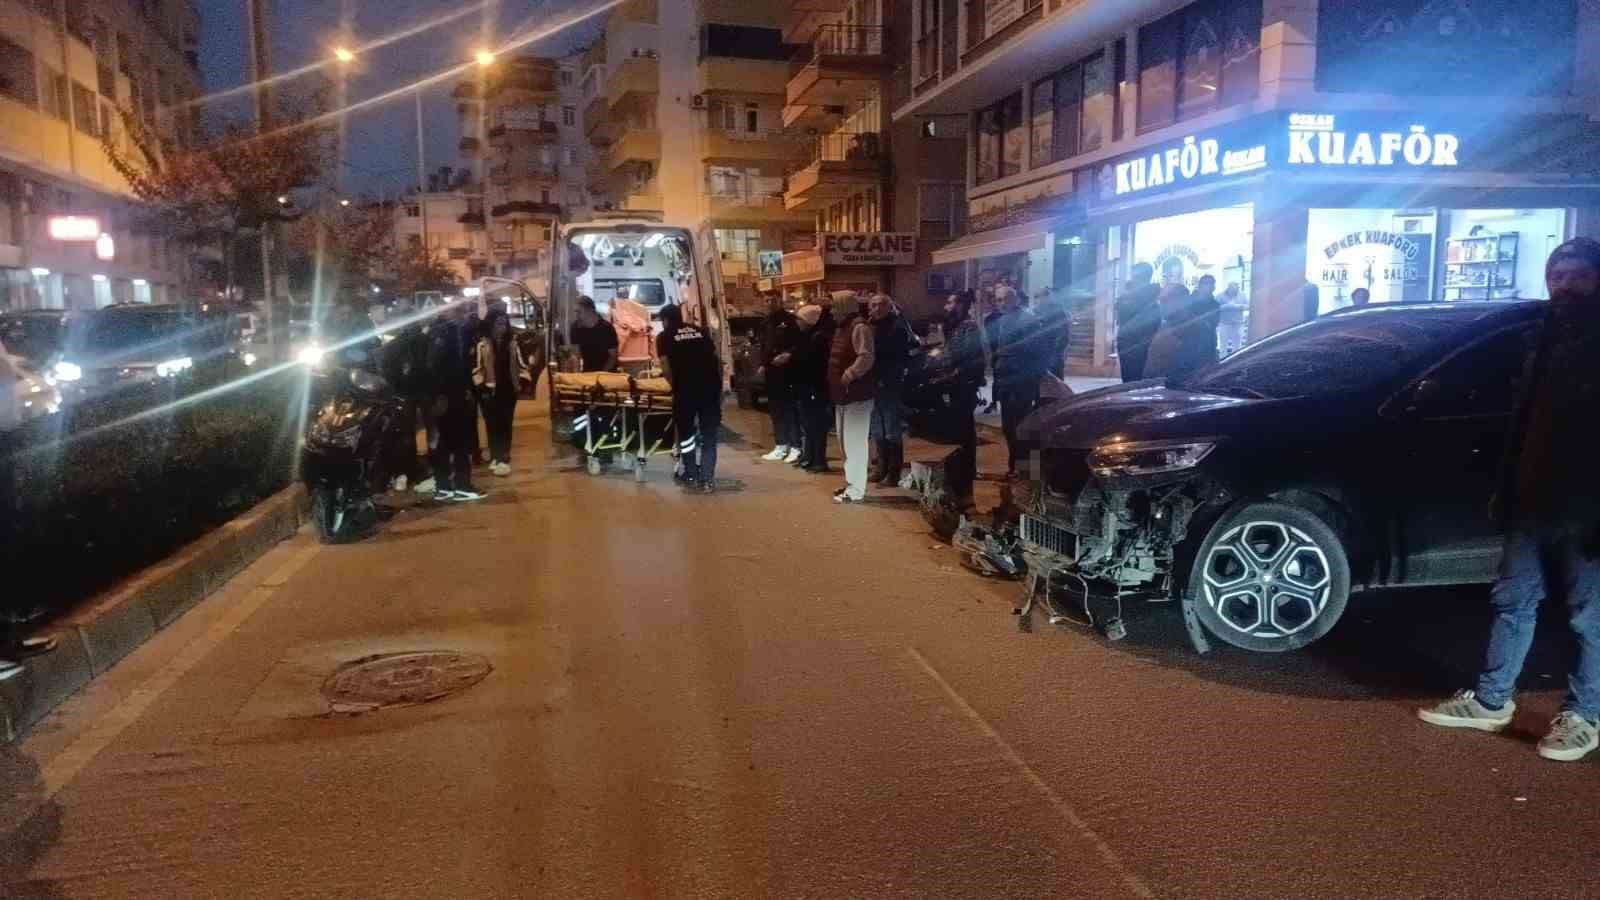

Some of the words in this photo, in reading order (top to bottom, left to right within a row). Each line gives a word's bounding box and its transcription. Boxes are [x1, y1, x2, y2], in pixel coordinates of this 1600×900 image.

[1288, 125, 1458, 165] KUAFÖR
[1115, 135, 1219, 194] KUAFÖR
[825, 235, 913, 252] ECZANE
[1323, 231, 1362, 259] ERKEK
[1322, 268, 1348, 281] HAIR
